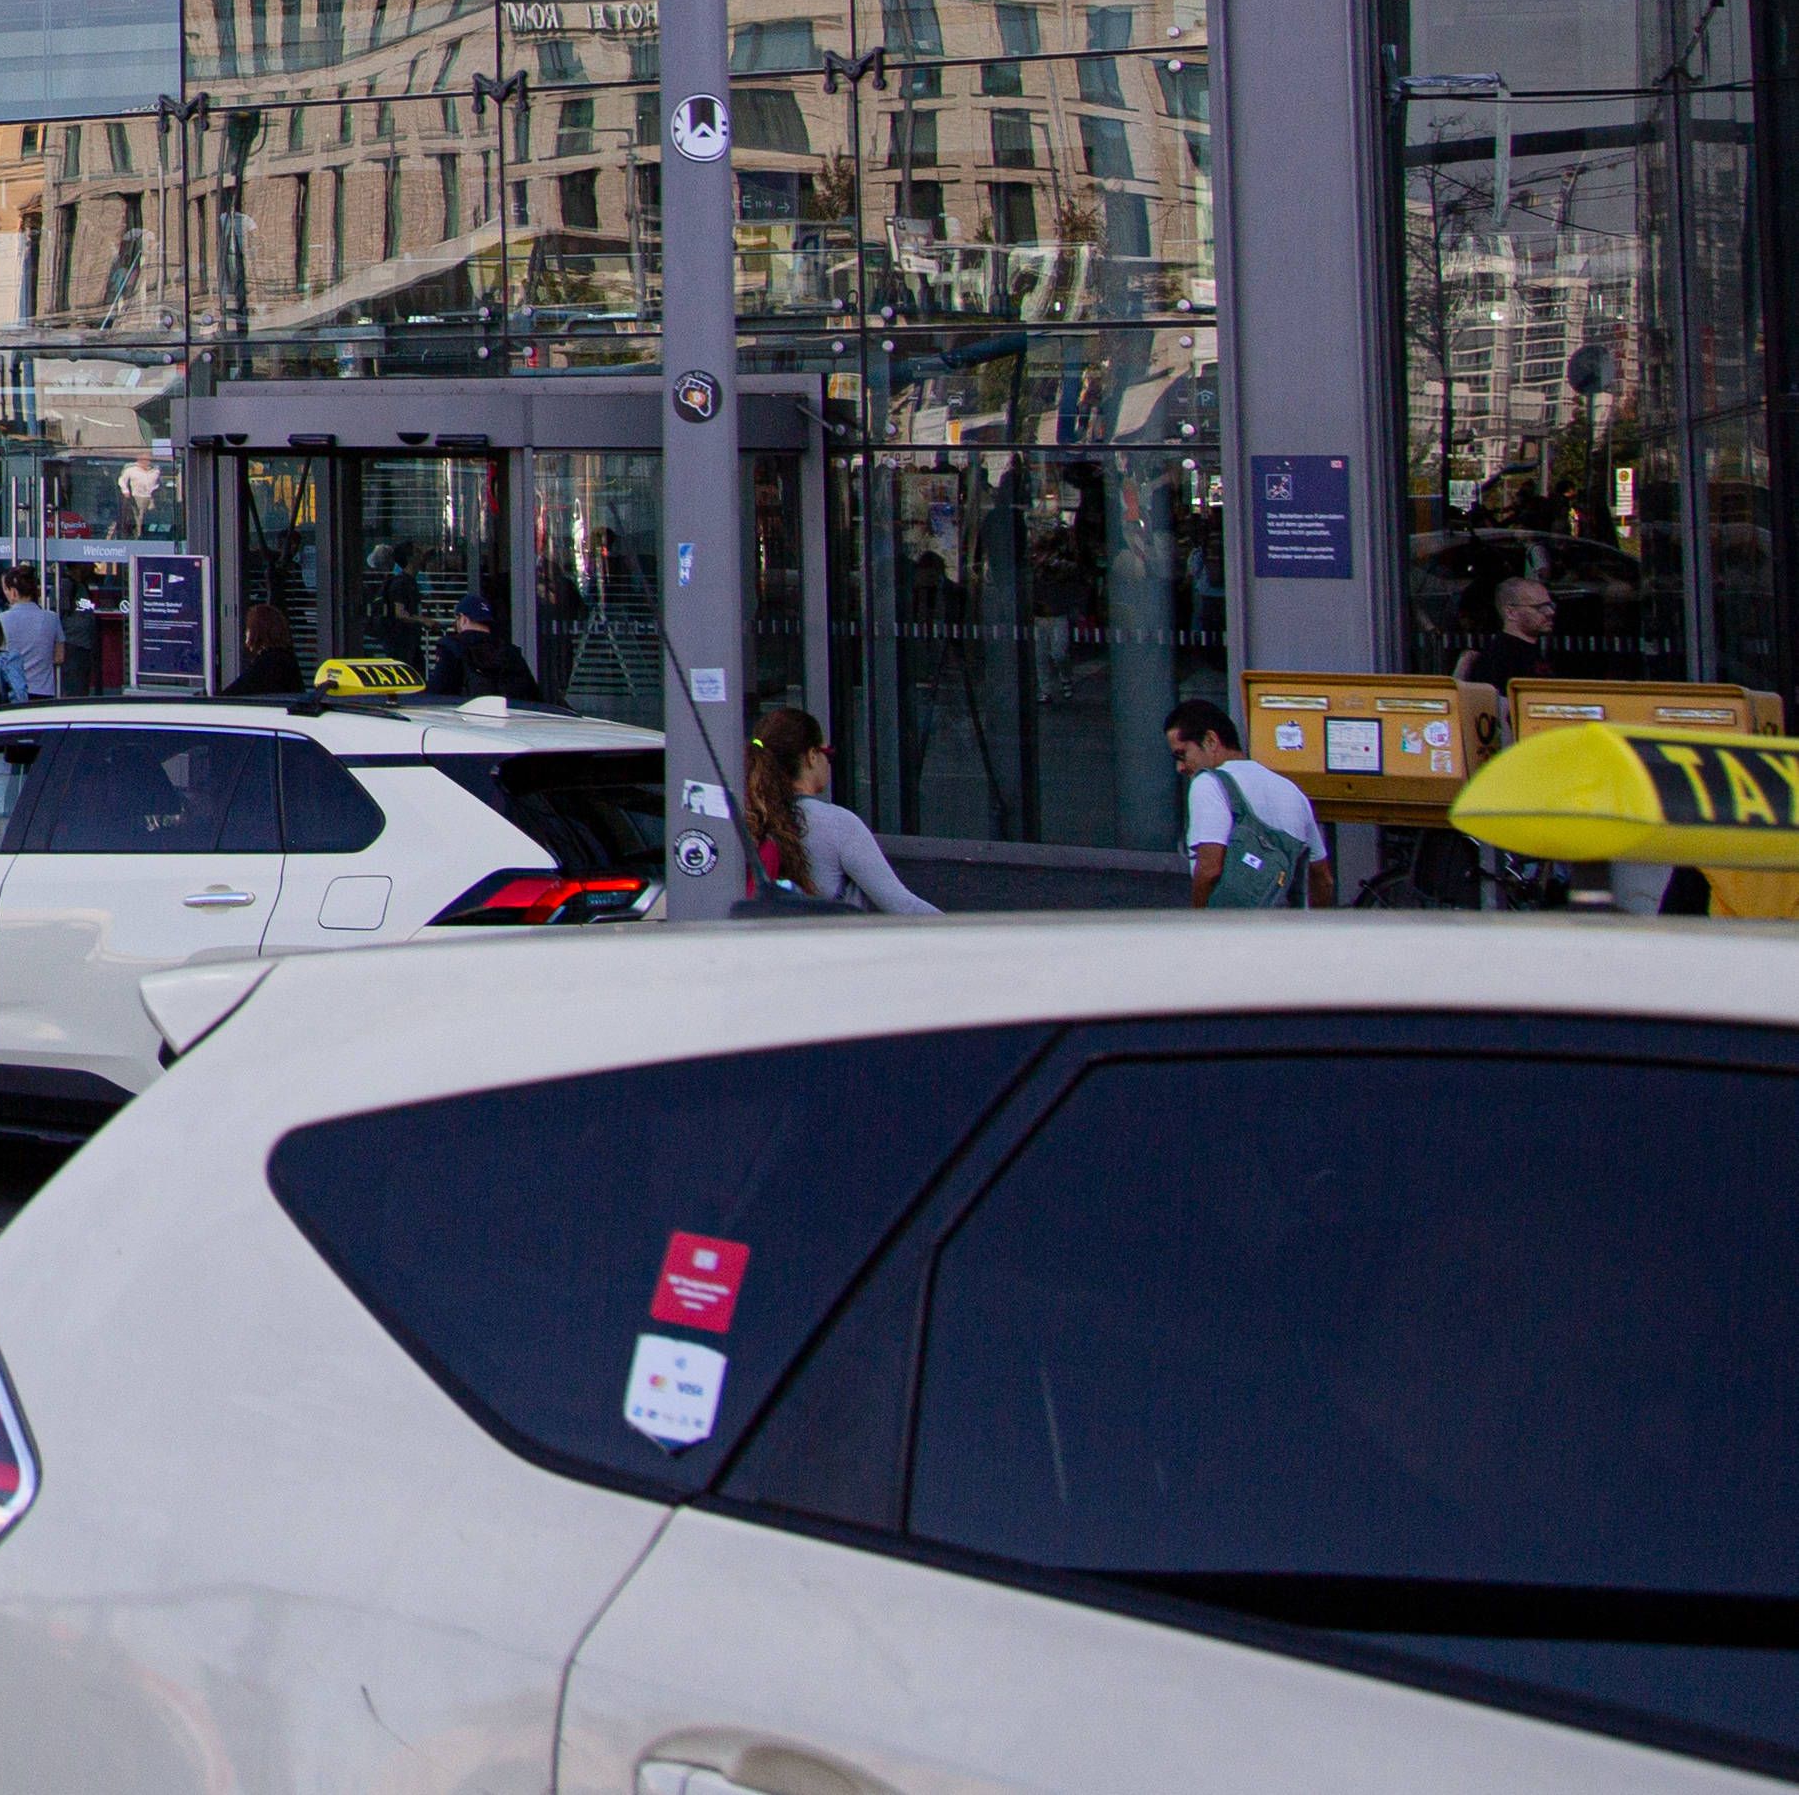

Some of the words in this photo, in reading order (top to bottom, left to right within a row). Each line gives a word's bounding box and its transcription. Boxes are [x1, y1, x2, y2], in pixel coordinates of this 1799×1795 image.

[82, 544, 127, 557] Welcome!
[355, 665, 417, 686] TAXI
[677, 1381, 704, 1397] VISA
